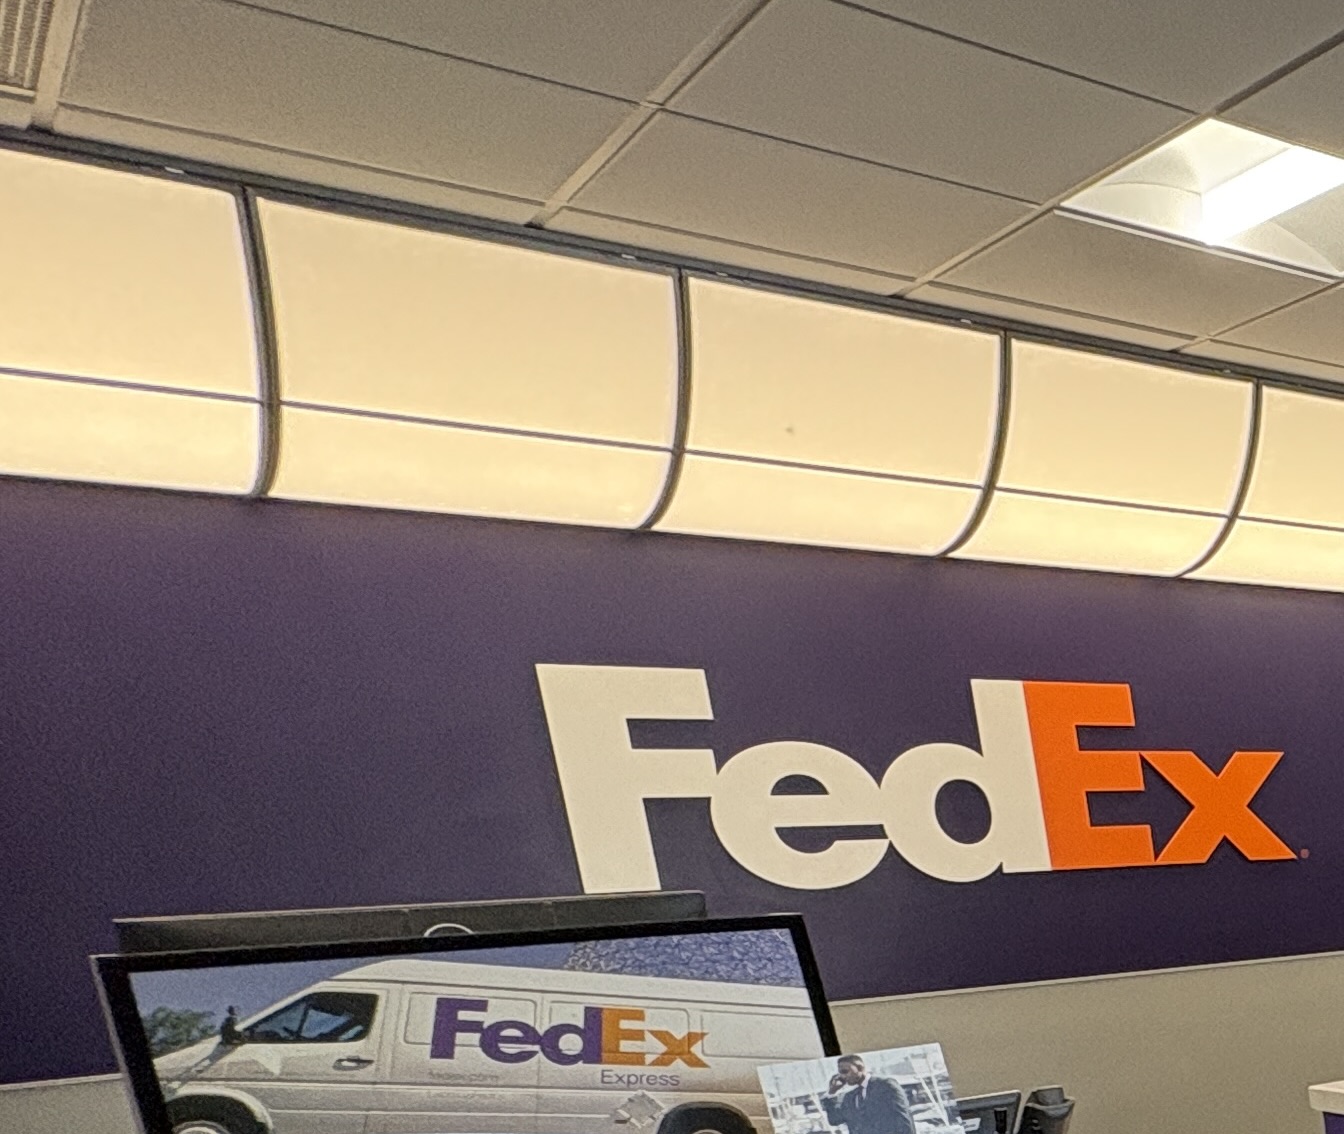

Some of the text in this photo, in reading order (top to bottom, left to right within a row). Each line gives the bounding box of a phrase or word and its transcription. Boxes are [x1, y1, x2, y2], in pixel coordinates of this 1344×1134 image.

[535, 664, 1299, 893] FedEx
[430, 996, 710, 1069] FedEx
[600, 1067, 681, 1090] Express
